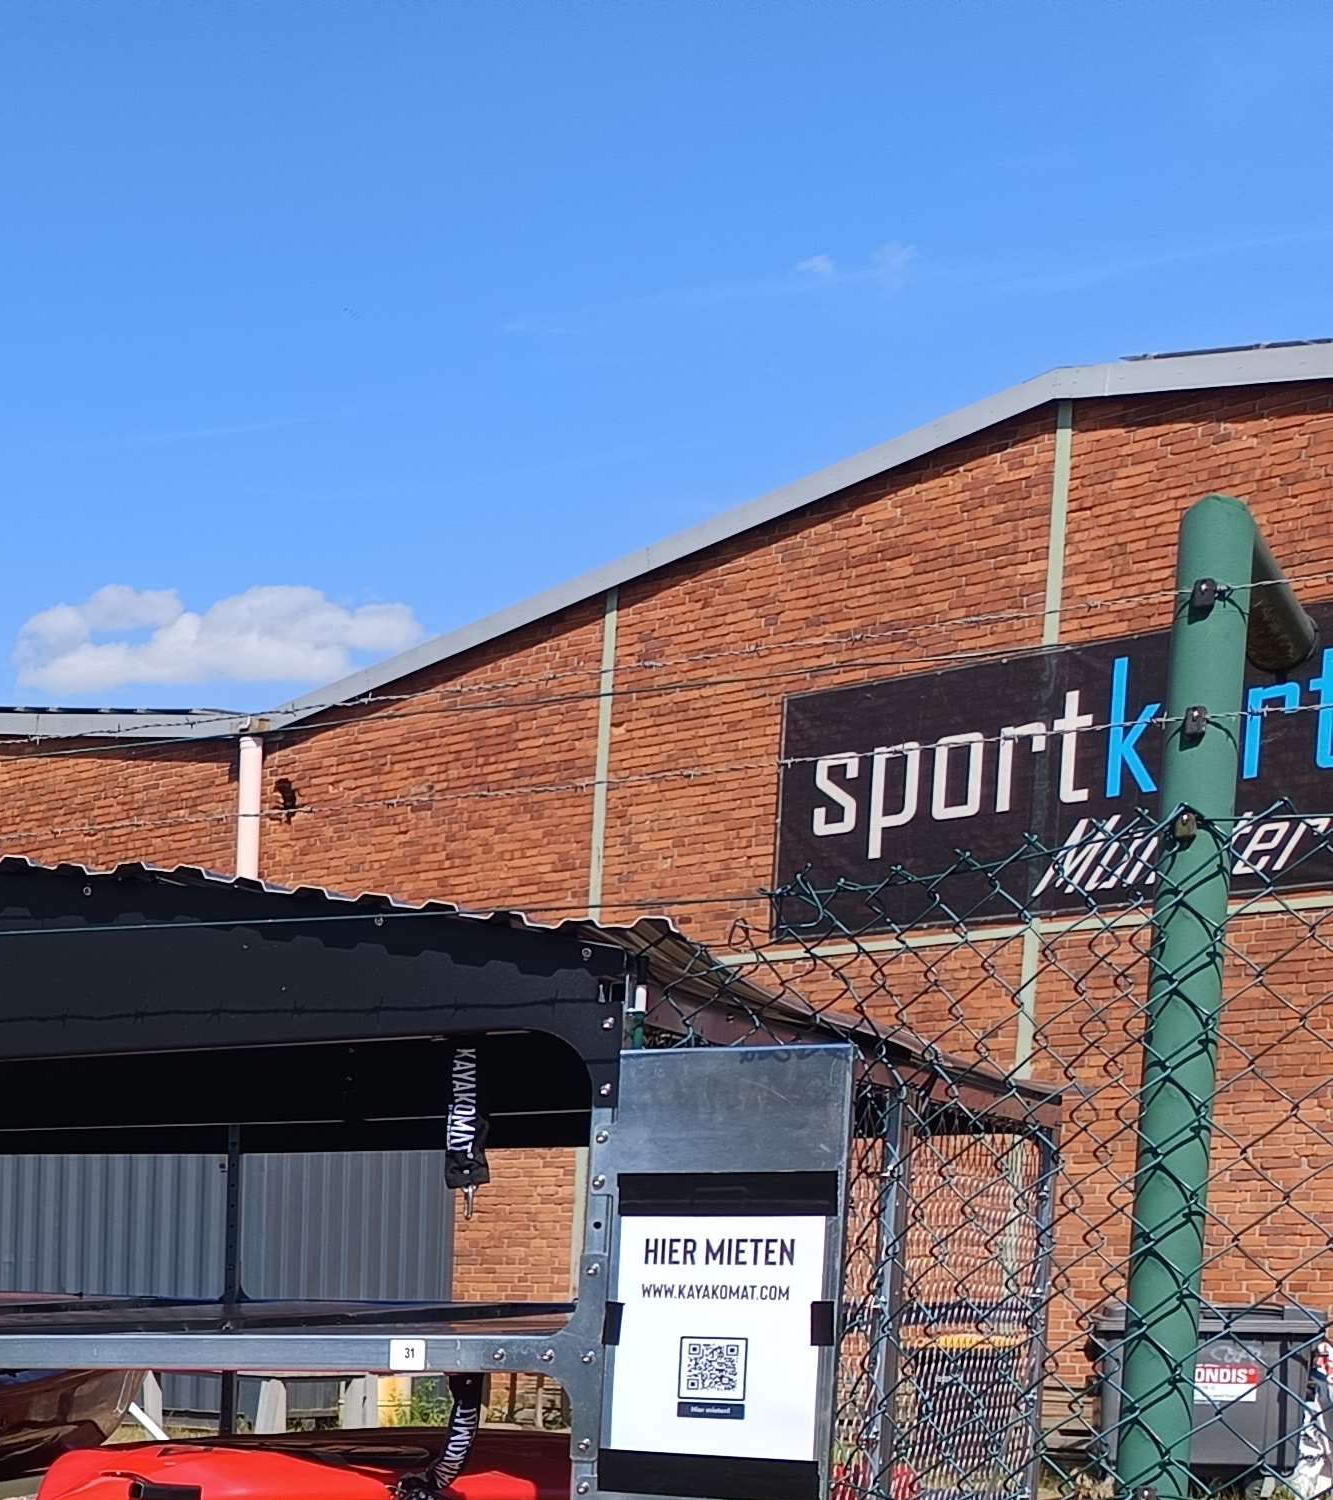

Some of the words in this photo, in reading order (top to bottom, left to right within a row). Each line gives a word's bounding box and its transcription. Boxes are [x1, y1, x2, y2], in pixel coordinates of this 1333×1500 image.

[813, 648, 1333, 860] sportkrt
[644, 1238, 697, 1265] HIER
[704, 1238, 796, 1266] MIETEN
[641, 1283, 790, 1301] WWW.KAYAKOMAT.COM
[404, 1347, 415, 1359] 31
